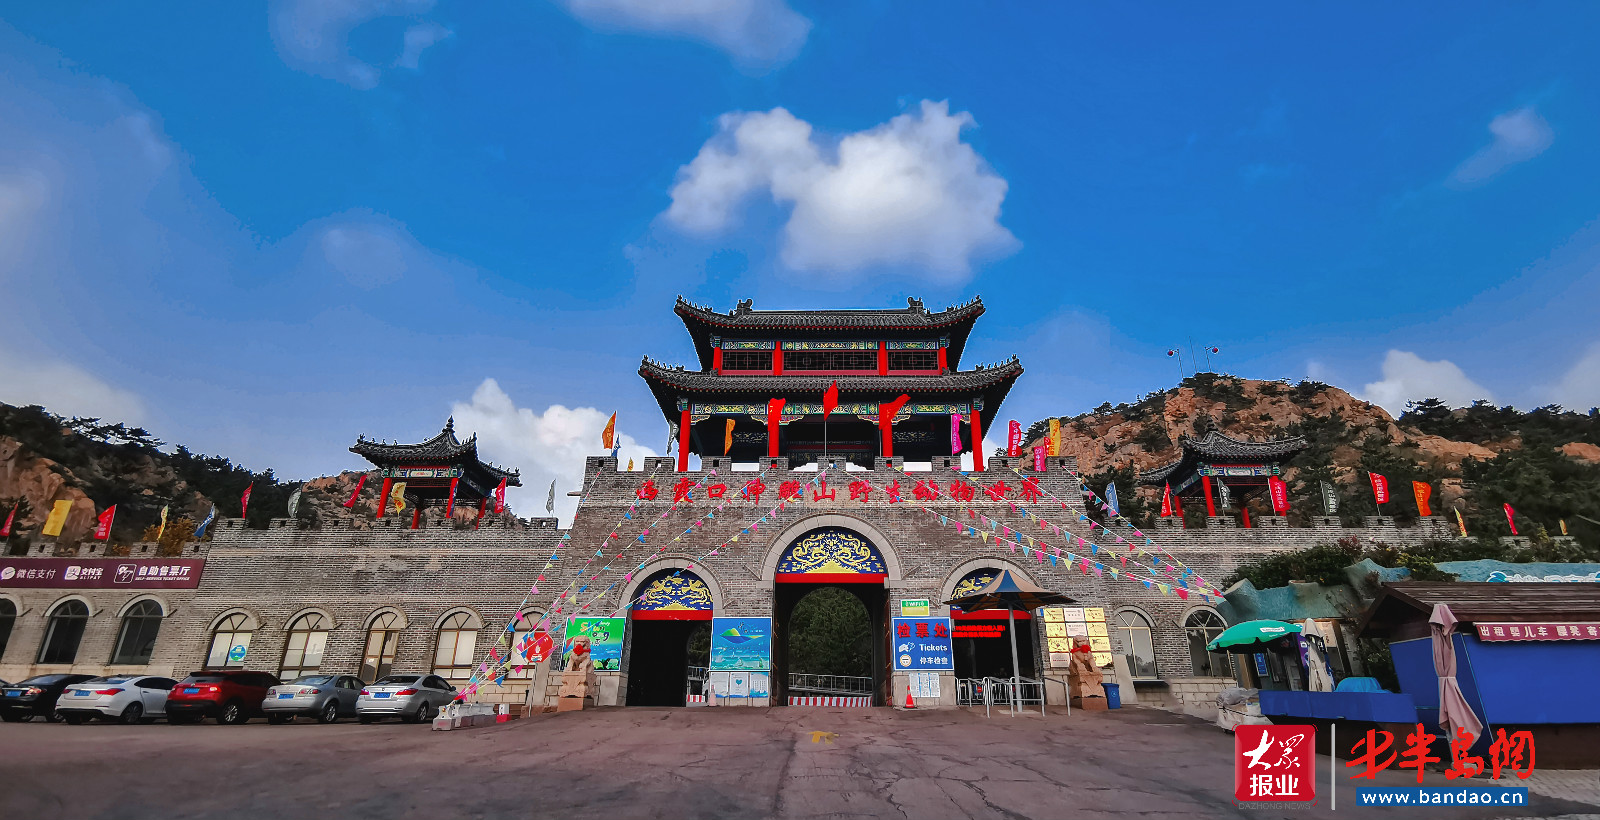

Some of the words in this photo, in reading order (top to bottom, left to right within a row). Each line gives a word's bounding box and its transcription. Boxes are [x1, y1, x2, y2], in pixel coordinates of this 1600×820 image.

[16, 568, 57, 579] 微信支付
[80, 567, 104, 576] 支付宝
[138, 565, 192, 576] 自助售票厅
[897, 622, 948, 639] 检票处
[918, 643, 949, 652] Tickets
